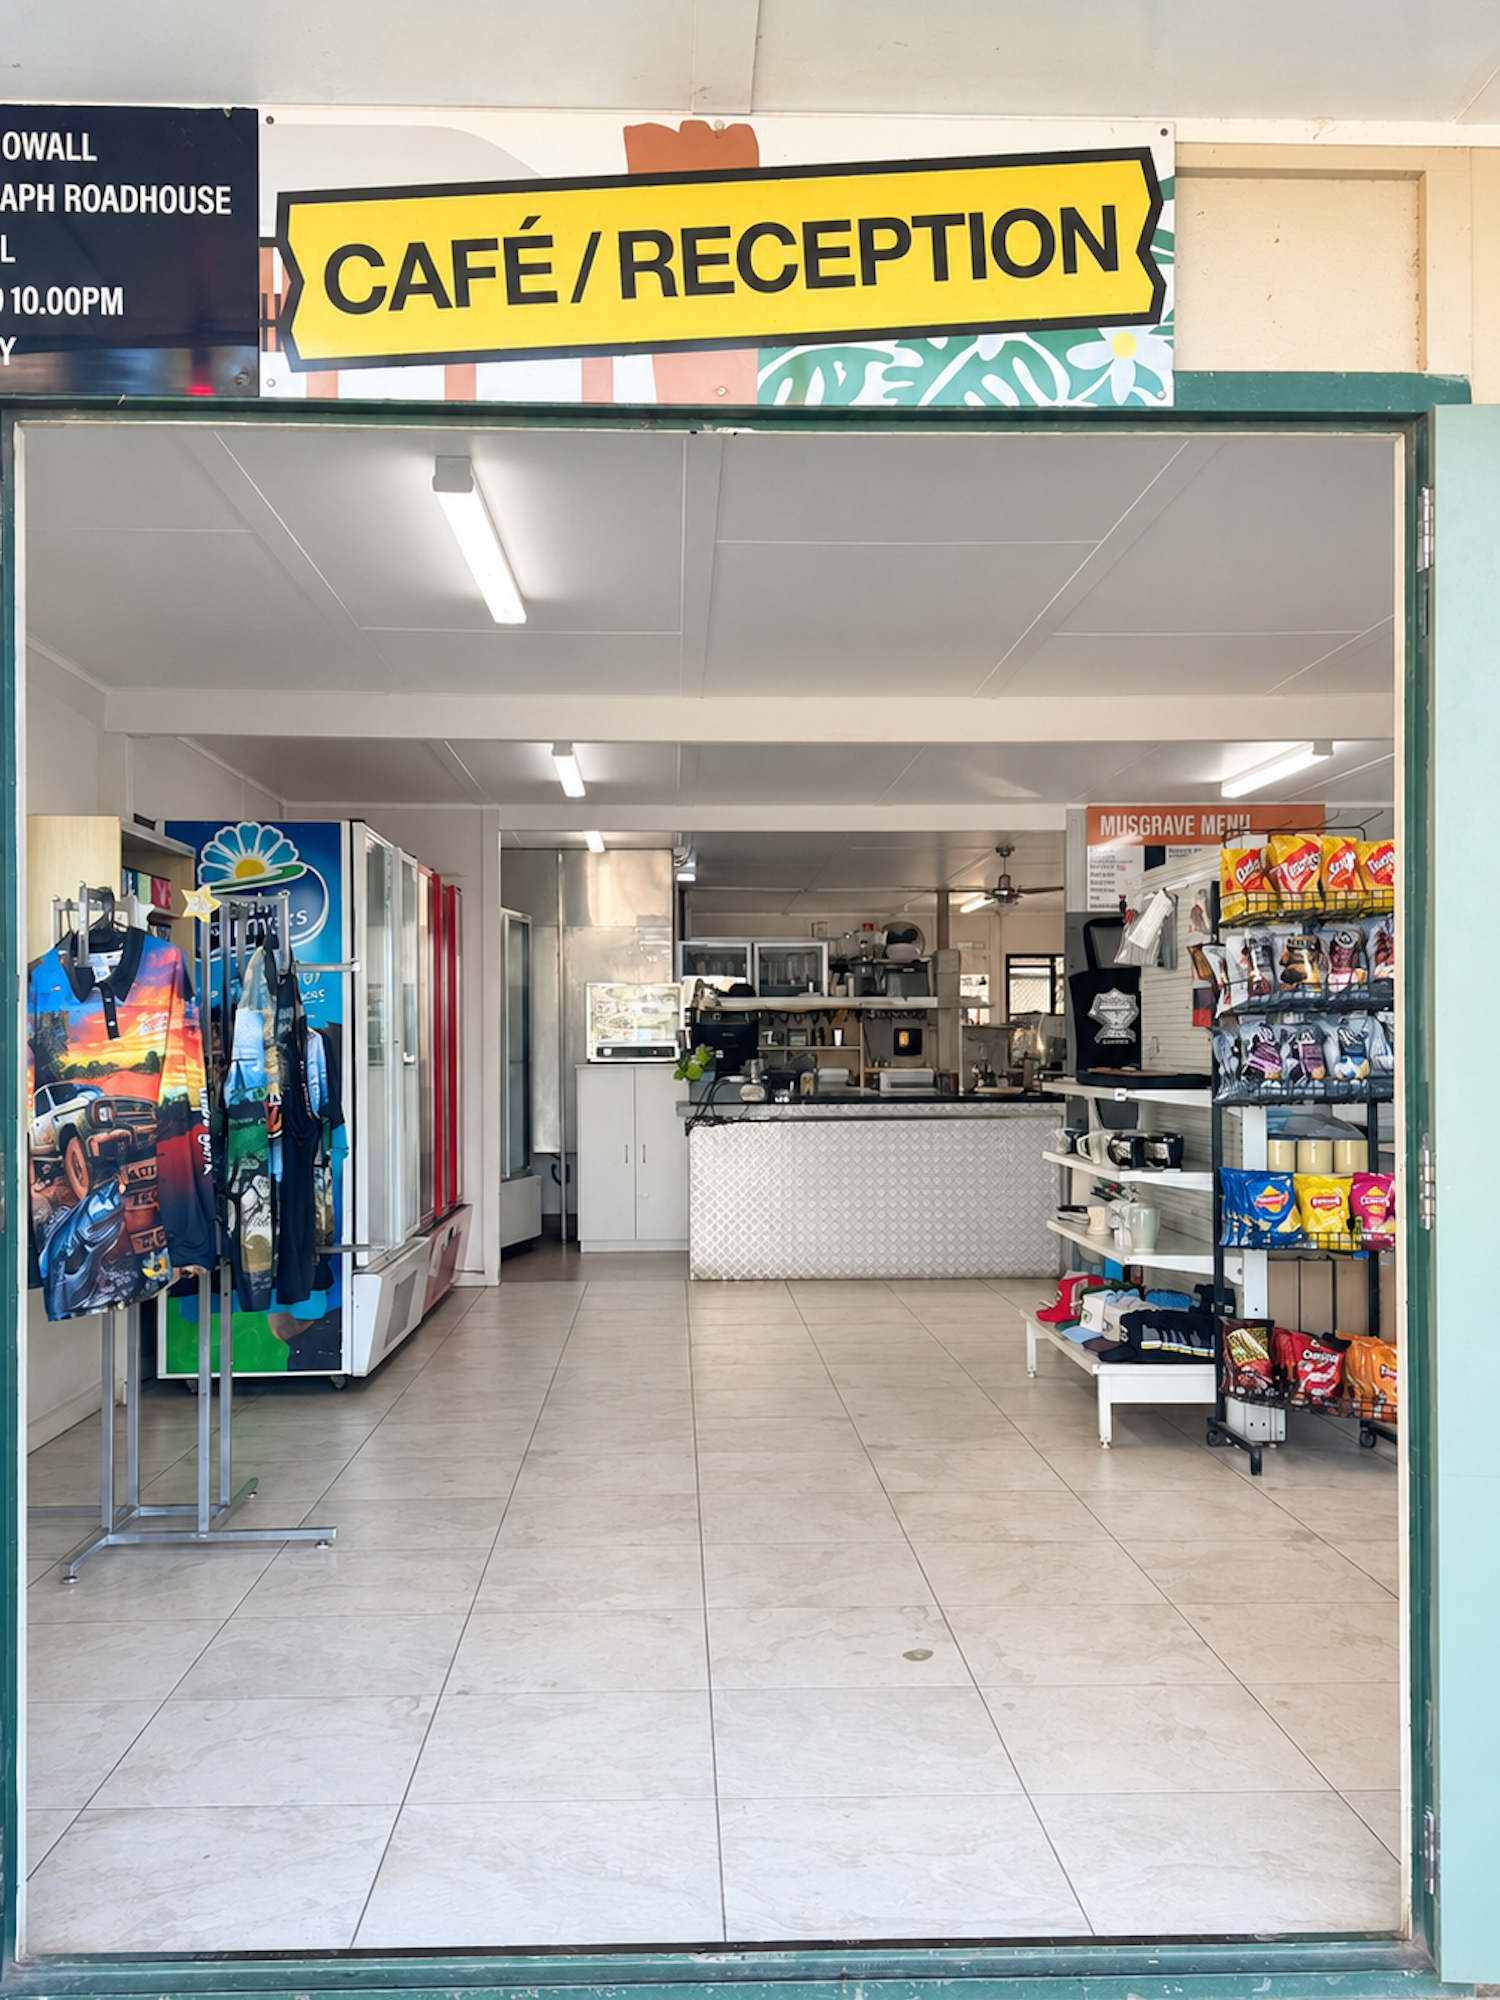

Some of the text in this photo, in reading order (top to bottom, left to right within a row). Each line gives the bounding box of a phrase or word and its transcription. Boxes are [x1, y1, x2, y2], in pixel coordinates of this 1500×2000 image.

[2, 131, 98, 162] OWALL
[0, 183, 232, 215] APH ROADHOUSE
[0, 234, 16, 263] L
[324, 215, 558, 315] CAFÉ
[618, 205, 1119, 300] RECEPTION
[10, 286, 124, 316] 10.00PM
[1100, 814, 1195, 836] MUSGRAVE
